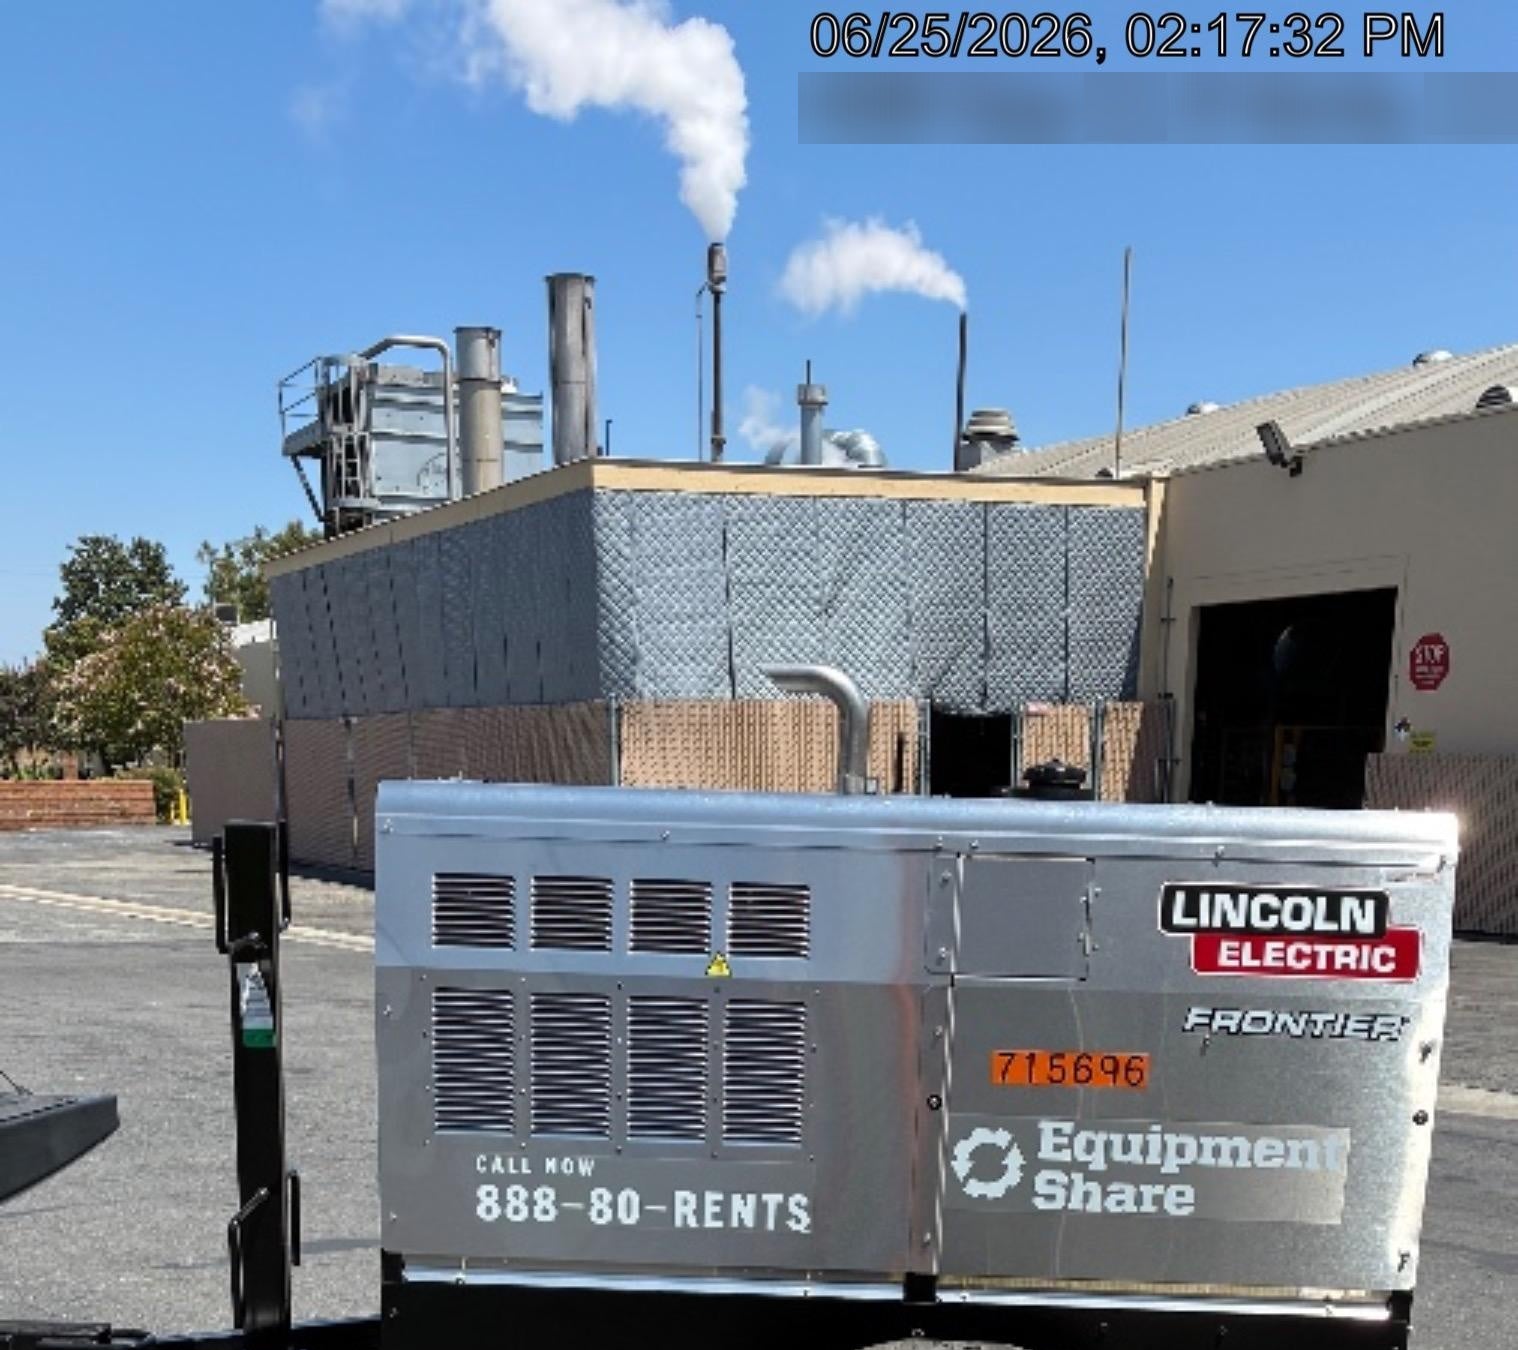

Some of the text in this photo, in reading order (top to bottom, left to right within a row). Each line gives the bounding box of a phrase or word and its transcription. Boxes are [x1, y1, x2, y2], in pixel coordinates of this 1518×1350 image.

[1172, 889, 1376, 934] LINCOLN
[1217, 940, 1397, 973] ELECTRIC
[1182, 1006, 1403, 1041] FRONTIER
[998, 1052, 1145, 1087] 715696
[475, 1154, 596, 1178] CALL NOW
[1037, 1120, 1342, 1173] Equipment
[475, 1183, 813, 1234] 888-80-RENTS
[1033, 1169, 1196, 1216] Share
